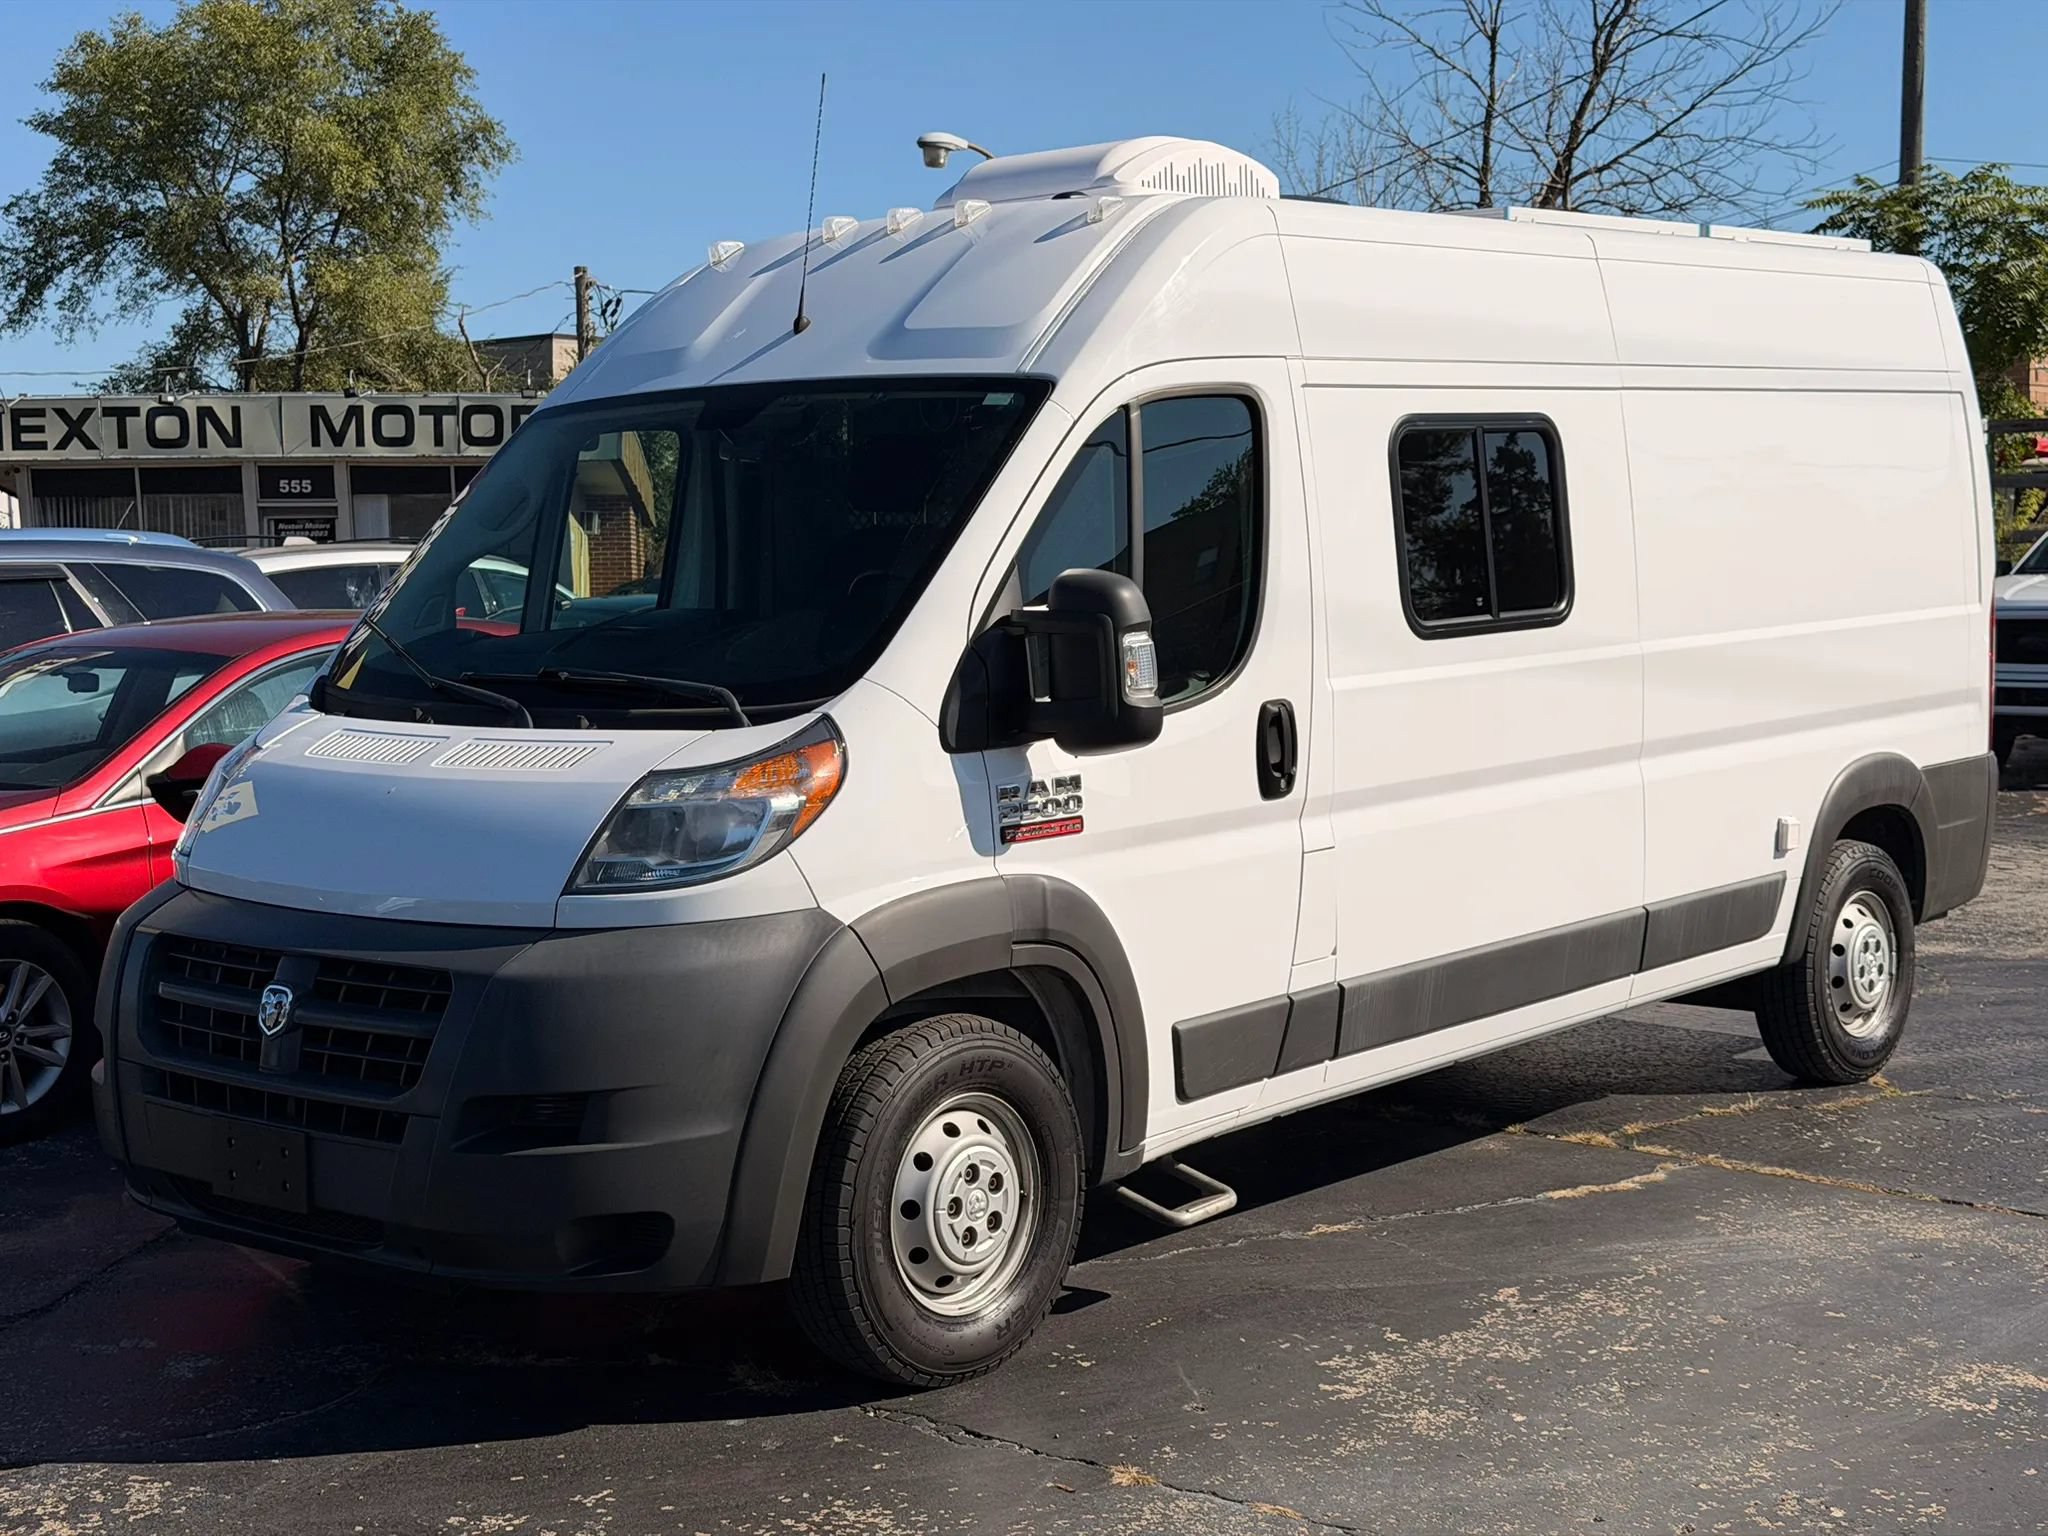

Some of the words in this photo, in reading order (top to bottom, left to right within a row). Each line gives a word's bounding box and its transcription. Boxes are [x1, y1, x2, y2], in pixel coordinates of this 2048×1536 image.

[0, 406, 243, 451] EXTON
[279, 479, 312, 493] 555
[996, 774, 1082, 803] RAM
[998, 795, 1083, 823] 2500
[960, 1058, 1005, 1076] HTP
